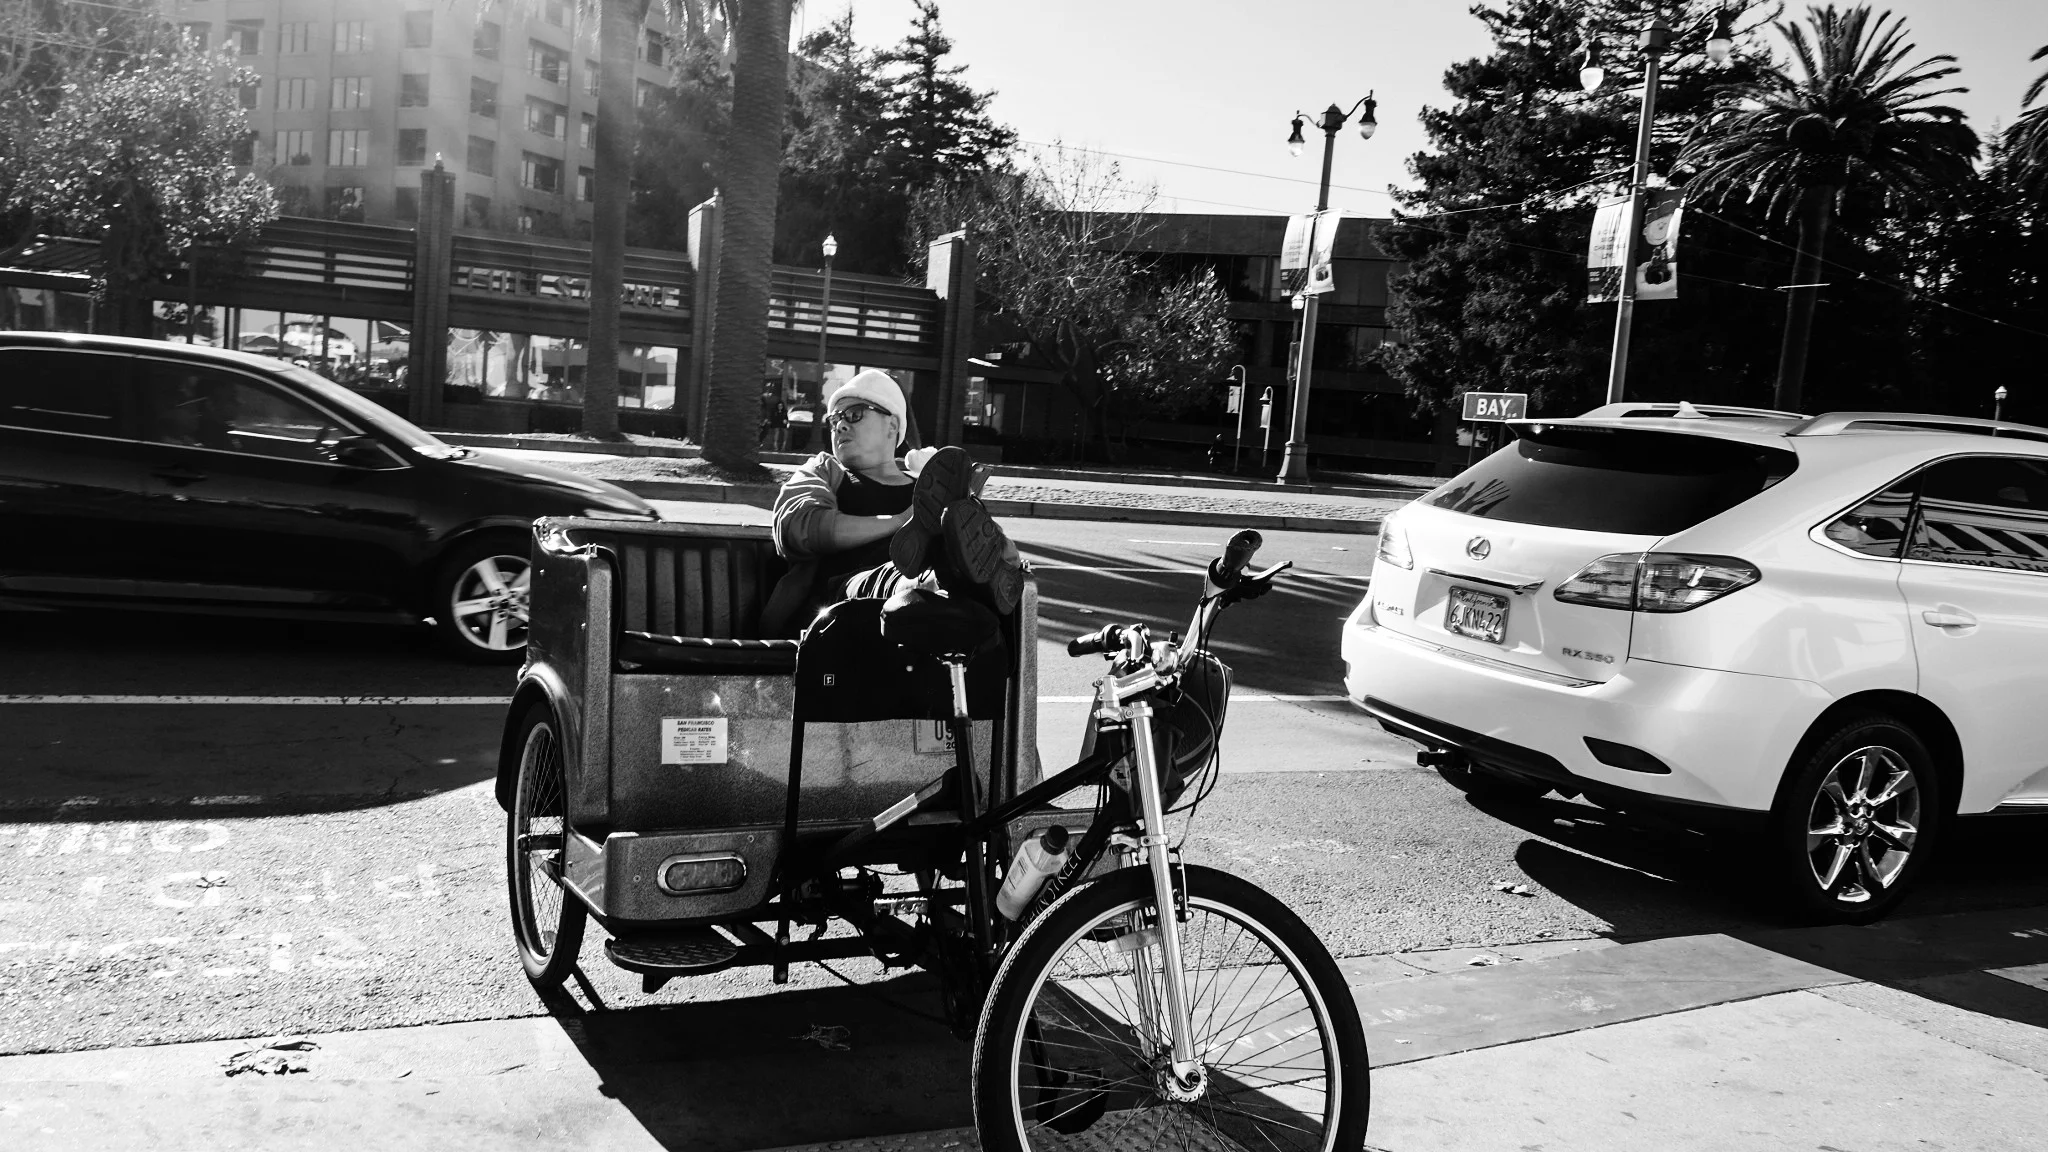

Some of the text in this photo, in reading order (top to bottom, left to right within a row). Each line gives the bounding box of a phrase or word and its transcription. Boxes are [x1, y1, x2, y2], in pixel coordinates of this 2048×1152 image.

[1477, 398, 1511, 416] BAY
[1450, 604, 1502, 634] 6JKN422
[1562, 647, 1582, 659] RX
